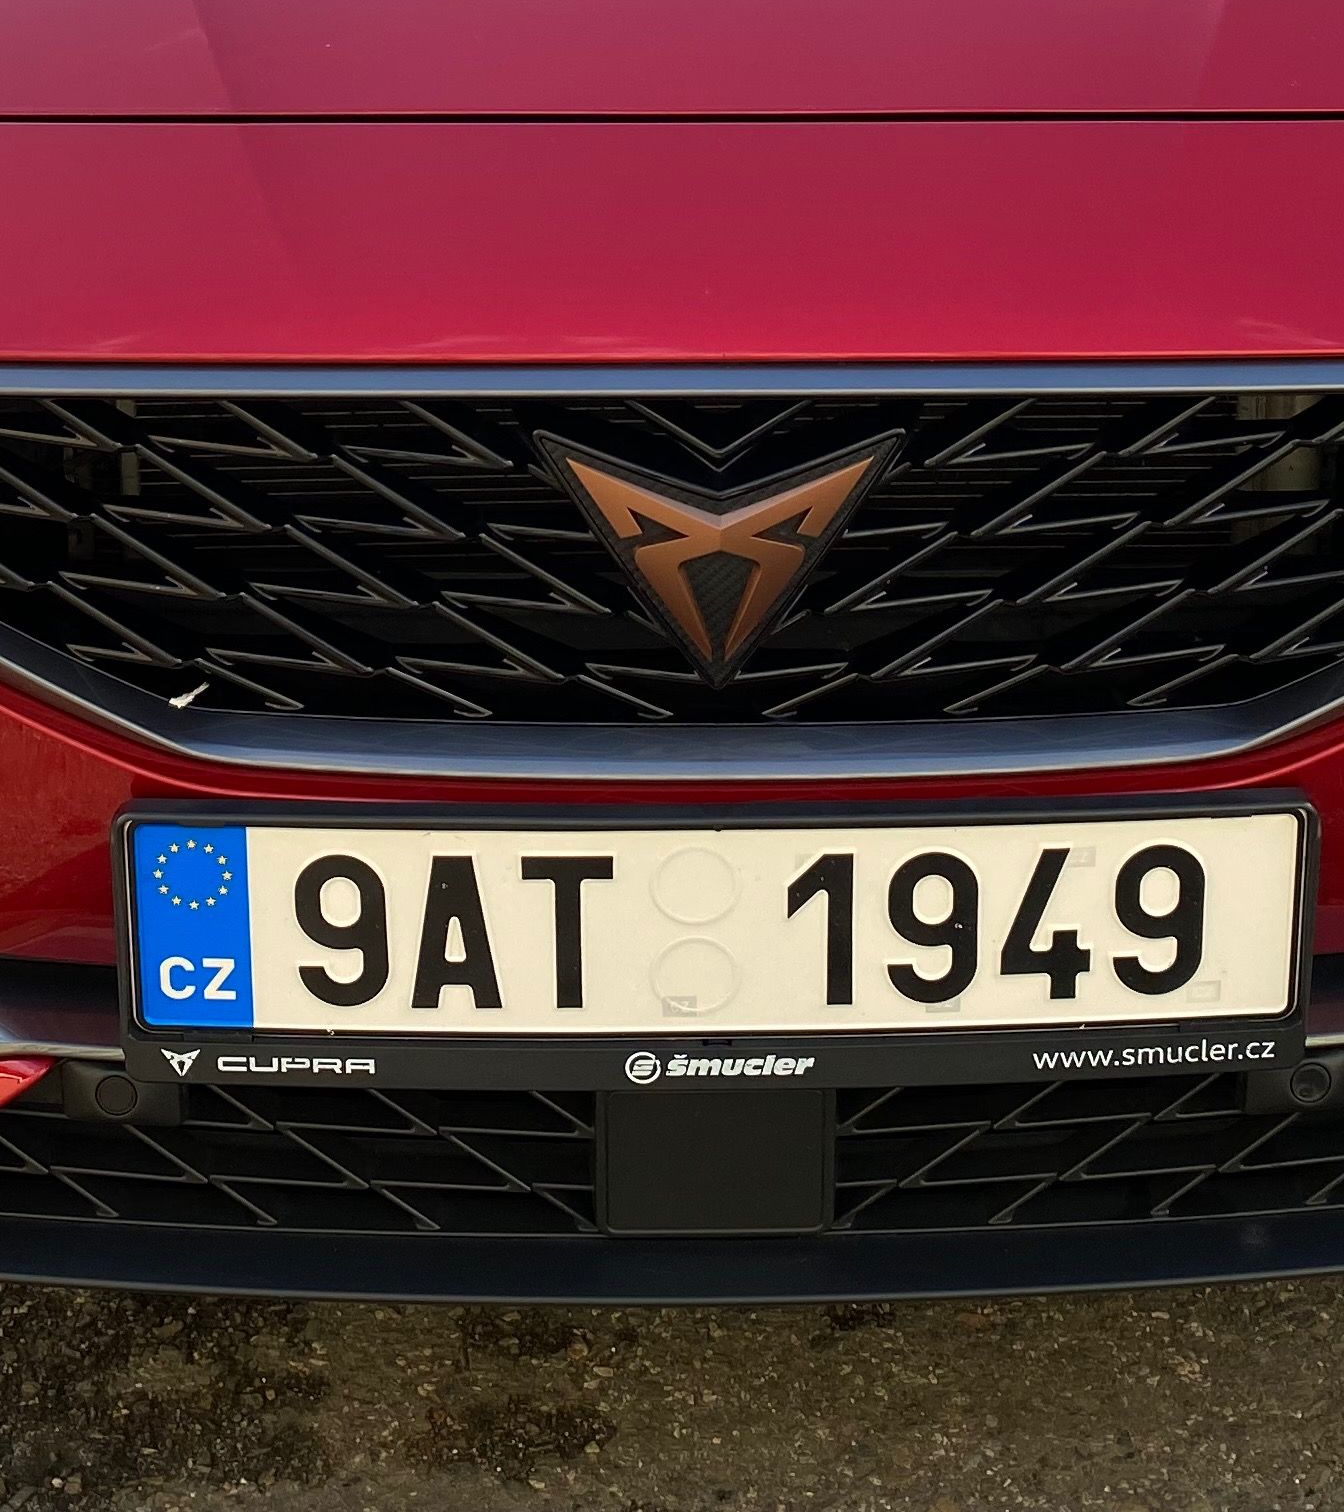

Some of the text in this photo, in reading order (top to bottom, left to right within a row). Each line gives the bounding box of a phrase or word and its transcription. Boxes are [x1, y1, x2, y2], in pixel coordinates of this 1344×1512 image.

[295, 844, 1205, 1008] 9AT 1949
[160, 957, 236, 999] CZ
[218, 1057, 375, 1074] CUPRA
[1033, 1039, 1274, 1069] www.smucler.cz
